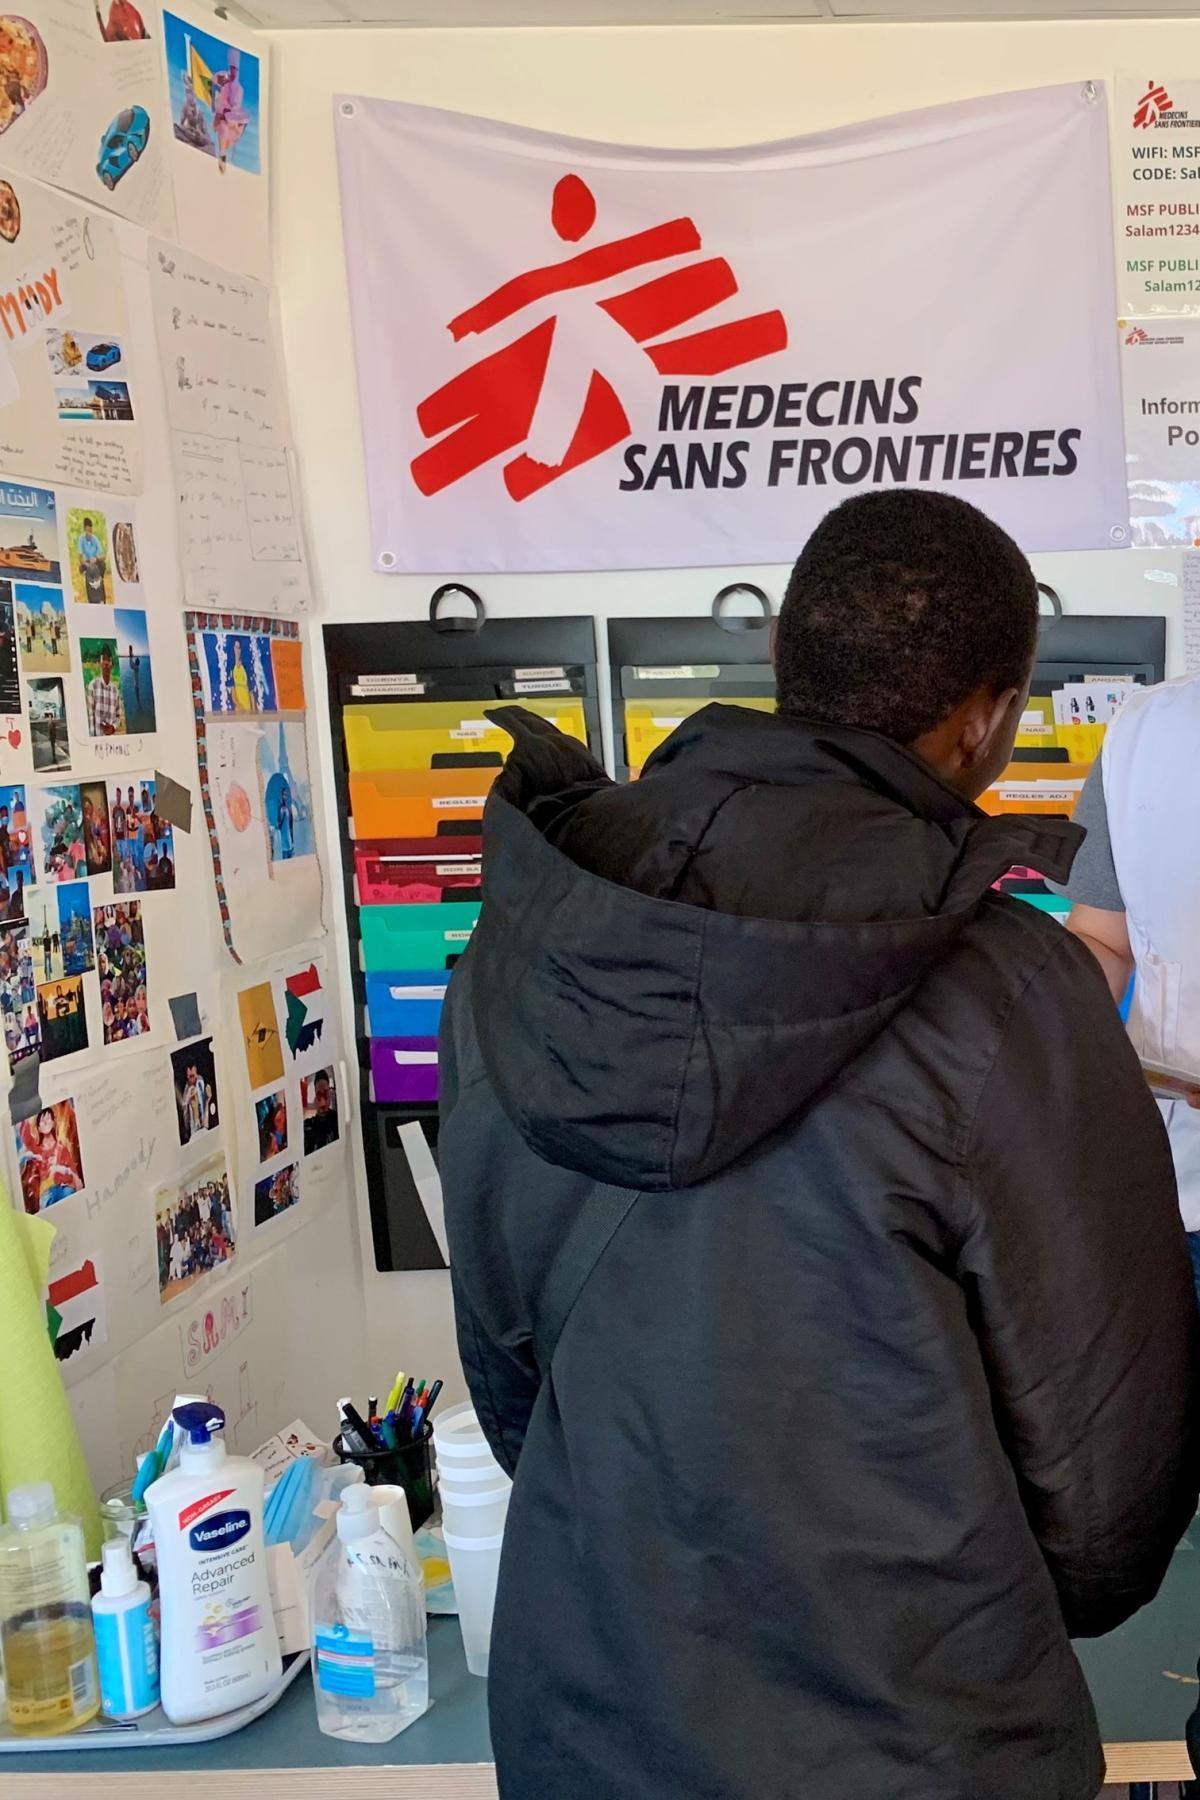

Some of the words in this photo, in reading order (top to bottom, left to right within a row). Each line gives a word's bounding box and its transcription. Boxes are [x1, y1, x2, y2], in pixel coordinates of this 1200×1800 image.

[1158, 111, 1188, 120] MEDECINS
[1154, 120, 1169, 128] SANS
[1132, 147, 1168, 159] WIFI:
[1132, 168, 1176, 180] CODE:
[1126, 205, 1155, 216] MSF
[1125, 225, 1200, 237] Salam1234
[1126, 261, 1155, 272] MSF
[658, 376, 922, 432] MEDECINS
[619, 440, 749, 491] SANS
[768, 428, 1081, 488] FRONTIERES
[194, 1519, 247, 1542] Vaseline
[192, 1552, 255, 1583] Advanced
[193, 1574, 235, 1595] Repair
